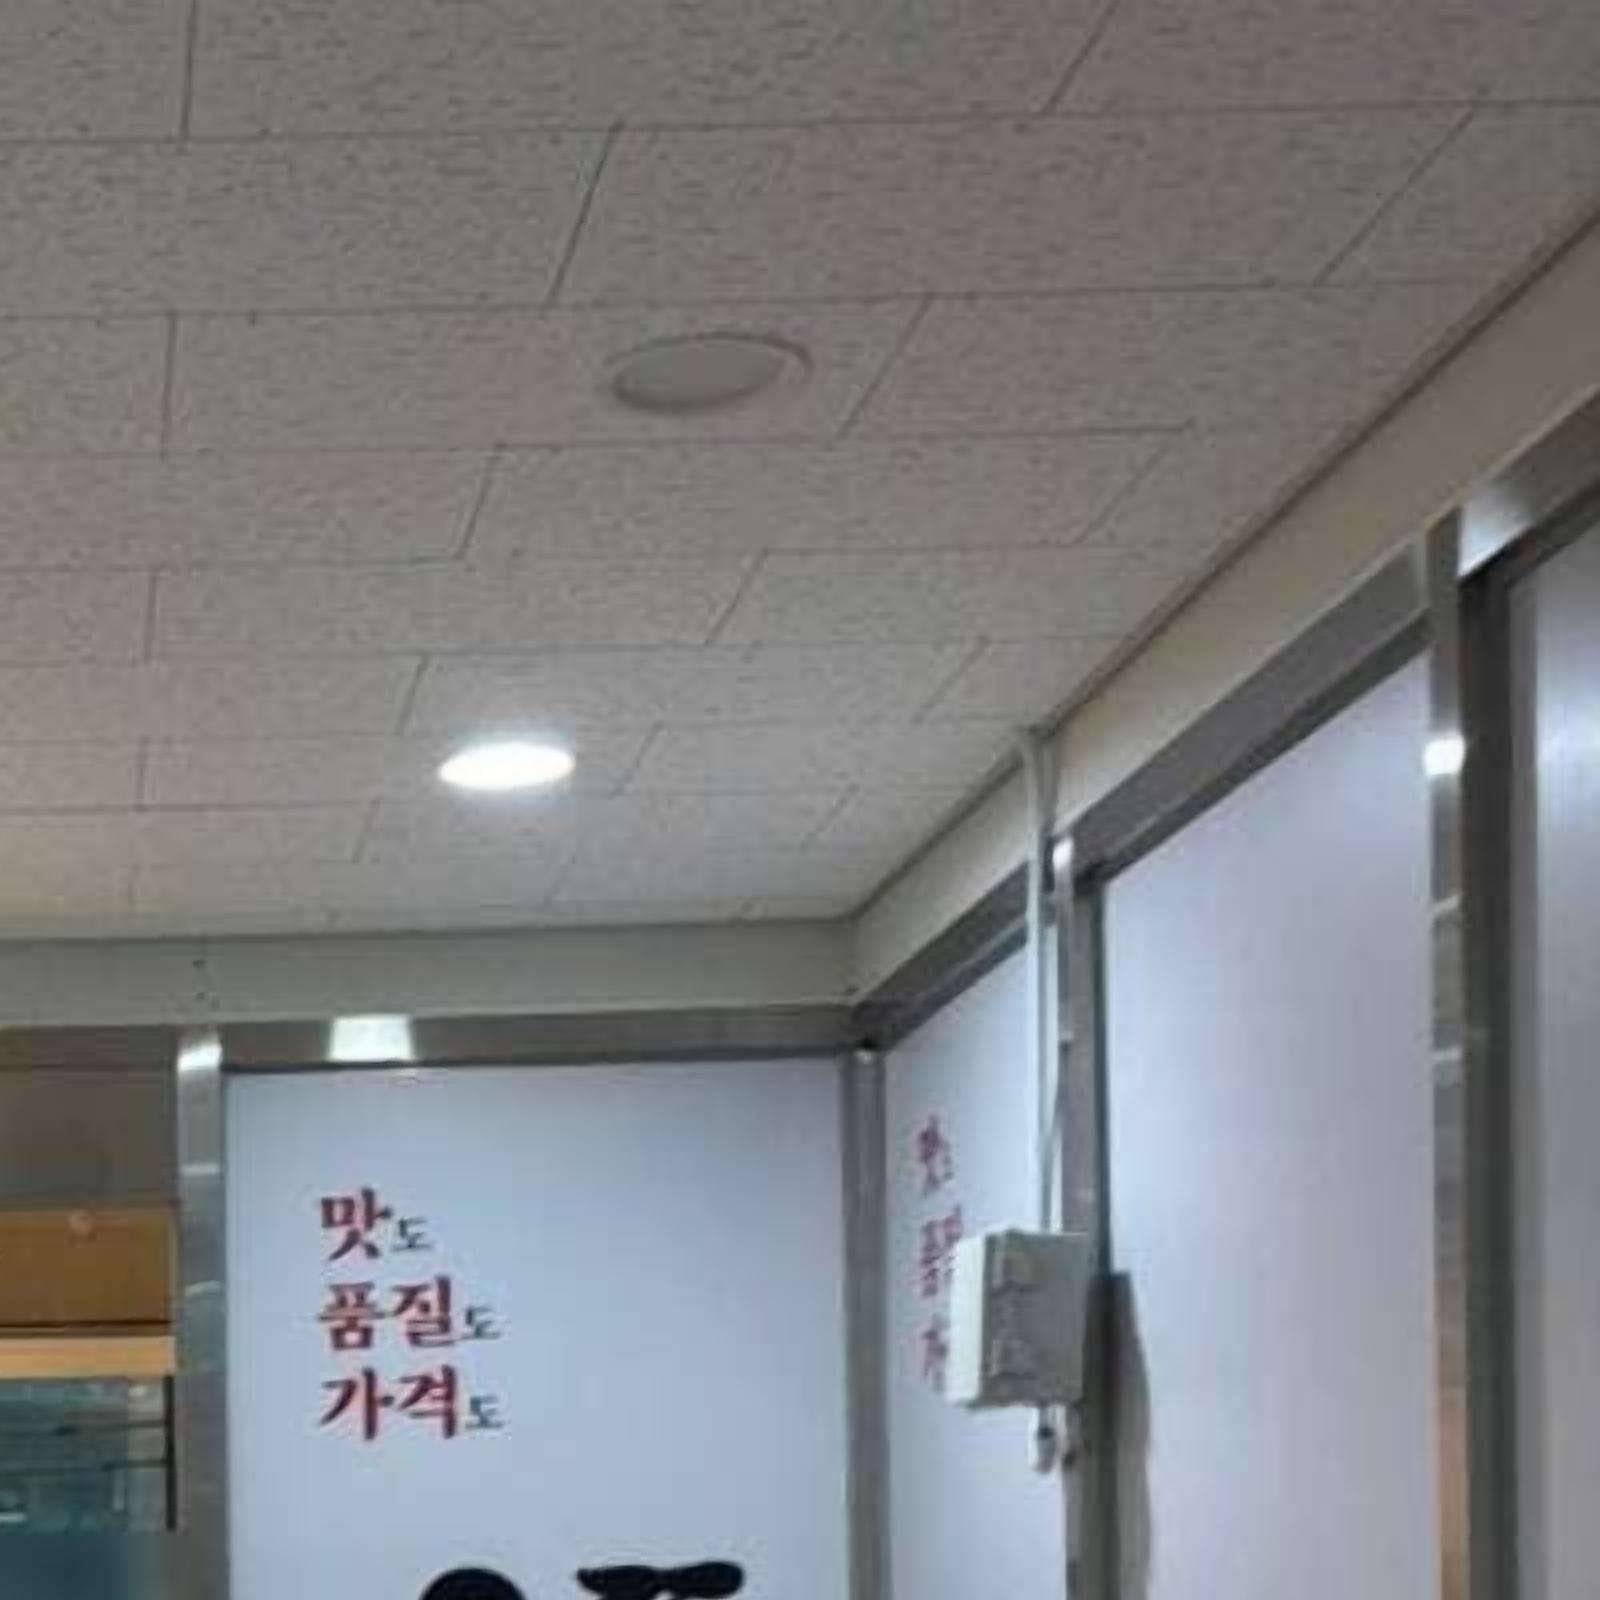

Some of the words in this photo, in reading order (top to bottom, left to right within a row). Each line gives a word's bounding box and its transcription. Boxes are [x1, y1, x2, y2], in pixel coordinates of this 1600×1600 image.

[320, 1186, 433, 1260] 맛도
[317, 1274, 501, 1350] 품질도
[319, 1364, 504, 1440] 가격도
